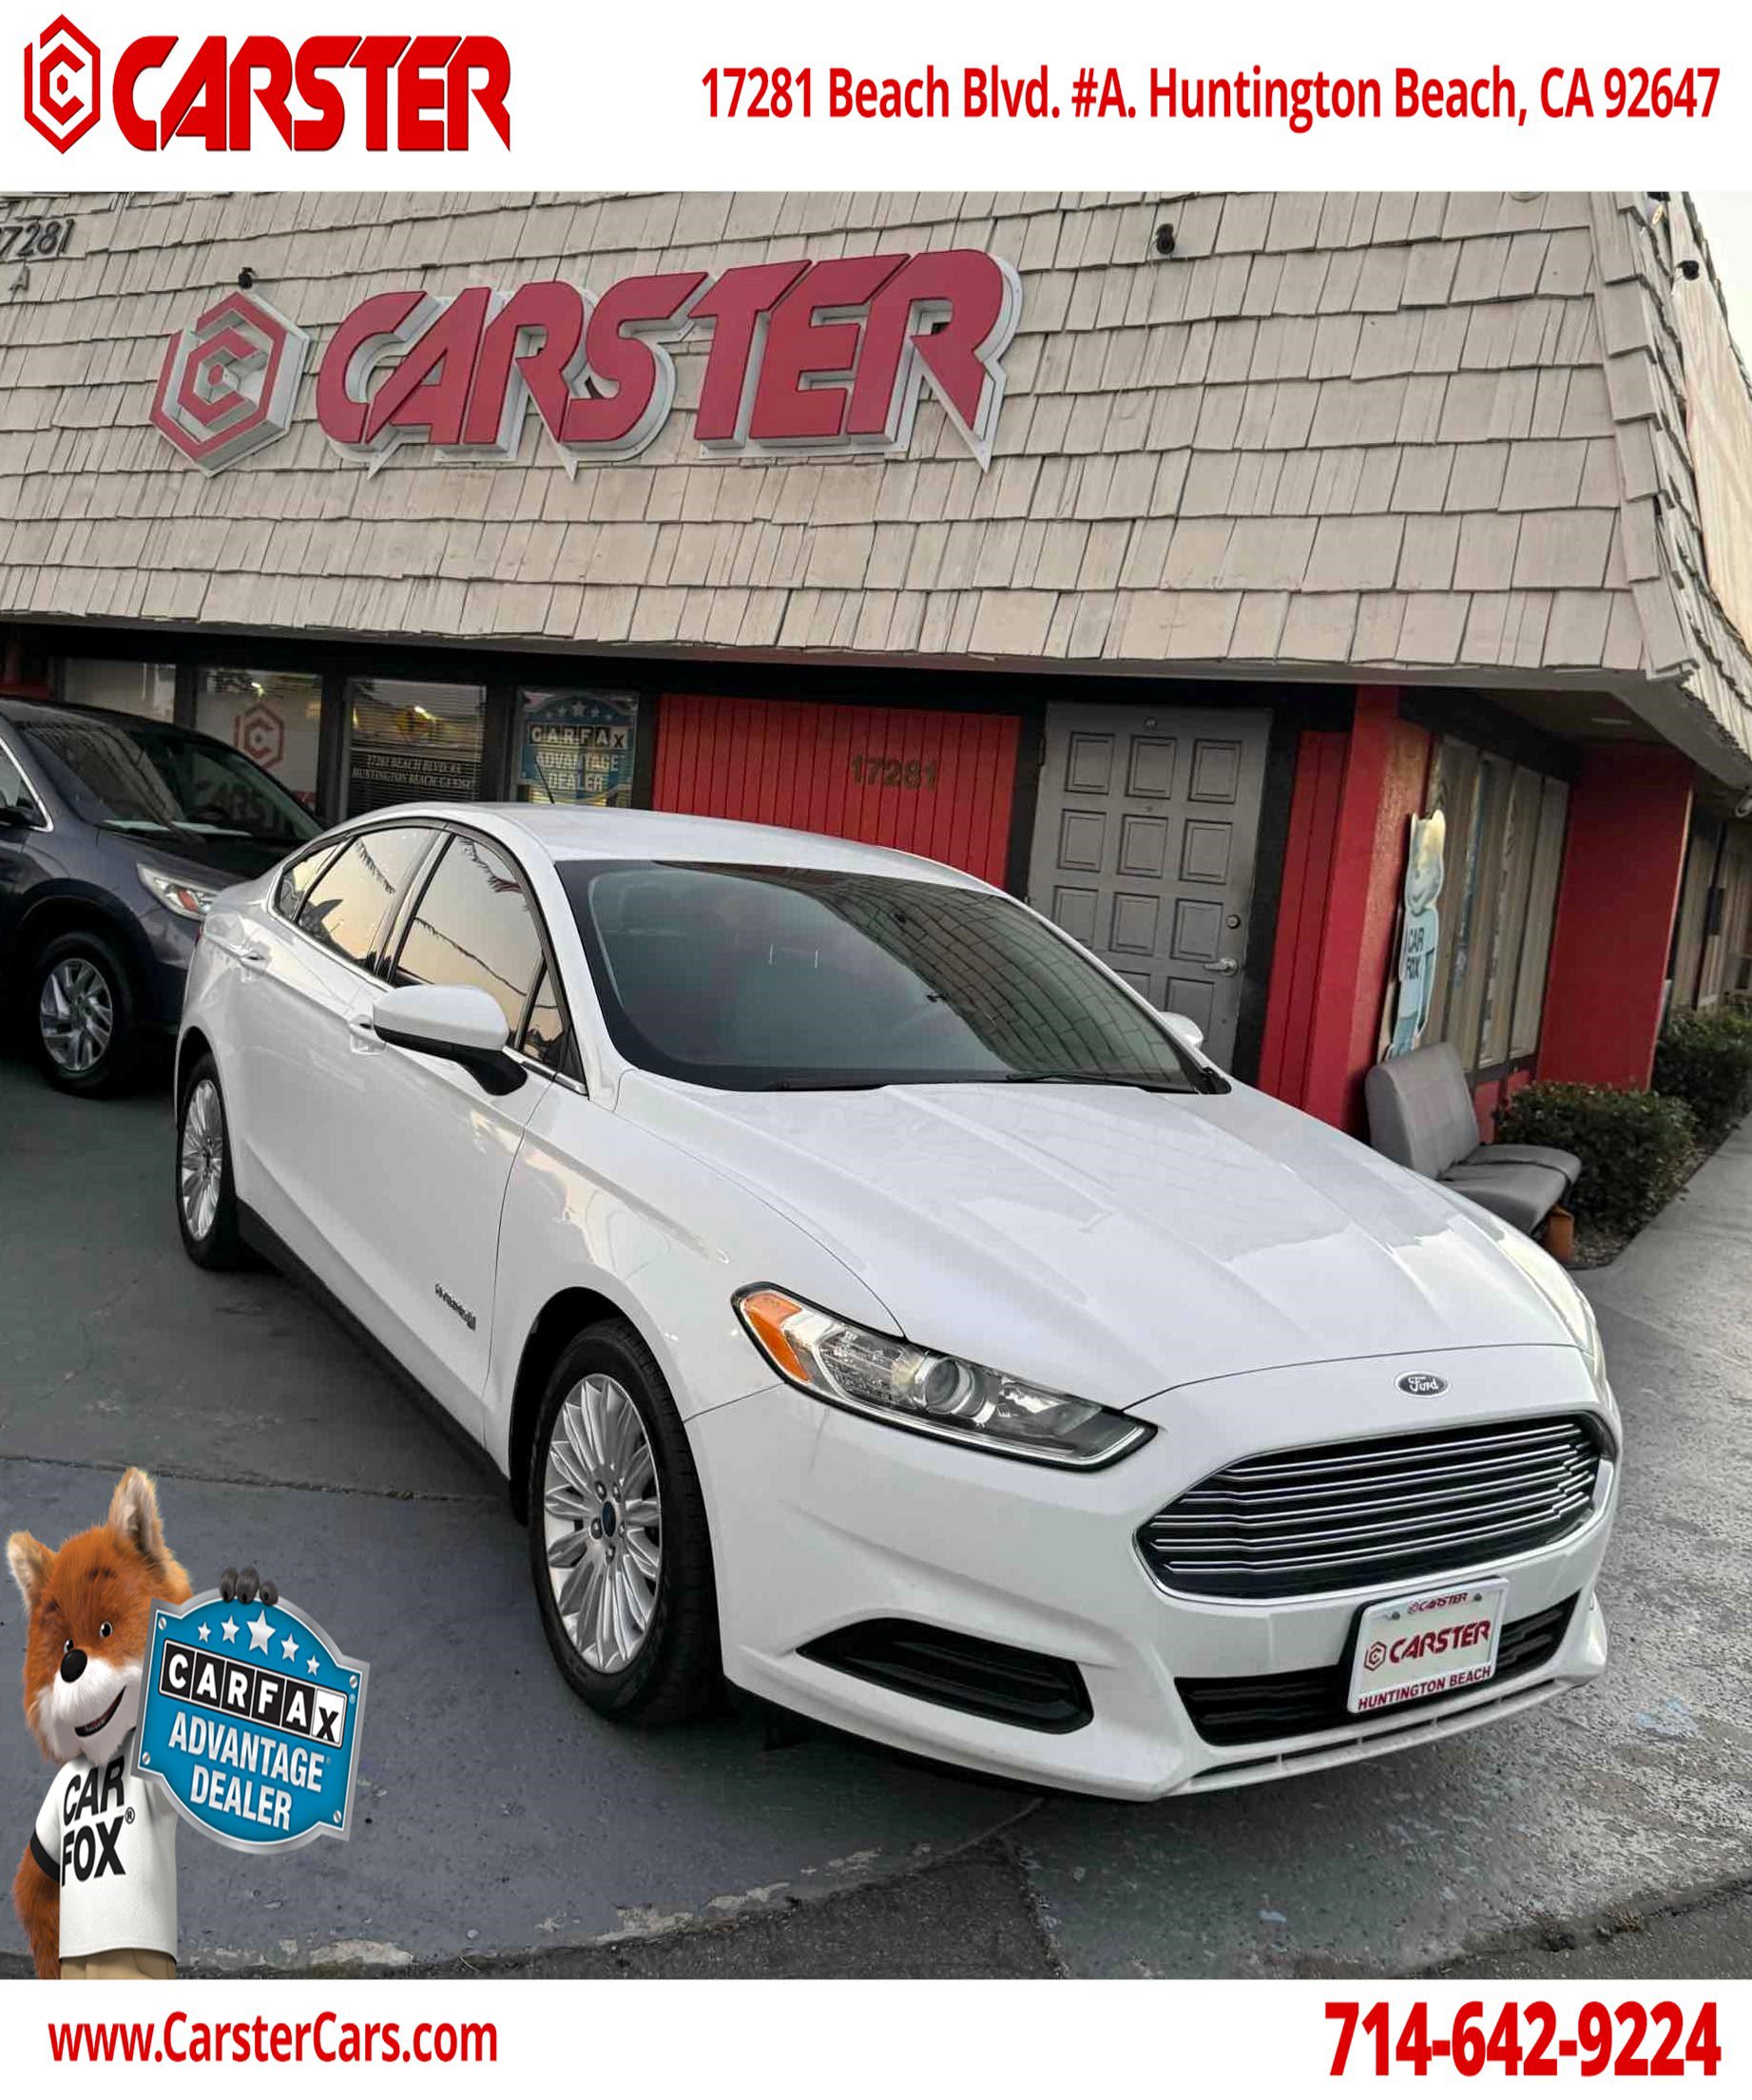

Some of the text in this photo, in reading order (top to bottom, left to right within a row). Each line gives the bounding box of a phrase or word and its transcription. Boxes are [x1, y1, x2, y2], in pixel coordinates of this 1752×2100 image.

[0, 218, 75, 258] 7281
[316, 248, 1010, 447] CARSTER
[530, 725, 626, 748] CARFAX
[851, 755, 936, 791] 17281
[1407, 927, 1425, 953] CAR
[1405, 956, 1422, 980] FOX
[1408, 1376, 1439, 1392] Ford
[1418, 1592, 1469, 1611] CARSTER
[1389, 1620, 1491, 1664] CARSTER
[1357, 1666, 1492, 1710] HUNTINGTON BEACH
